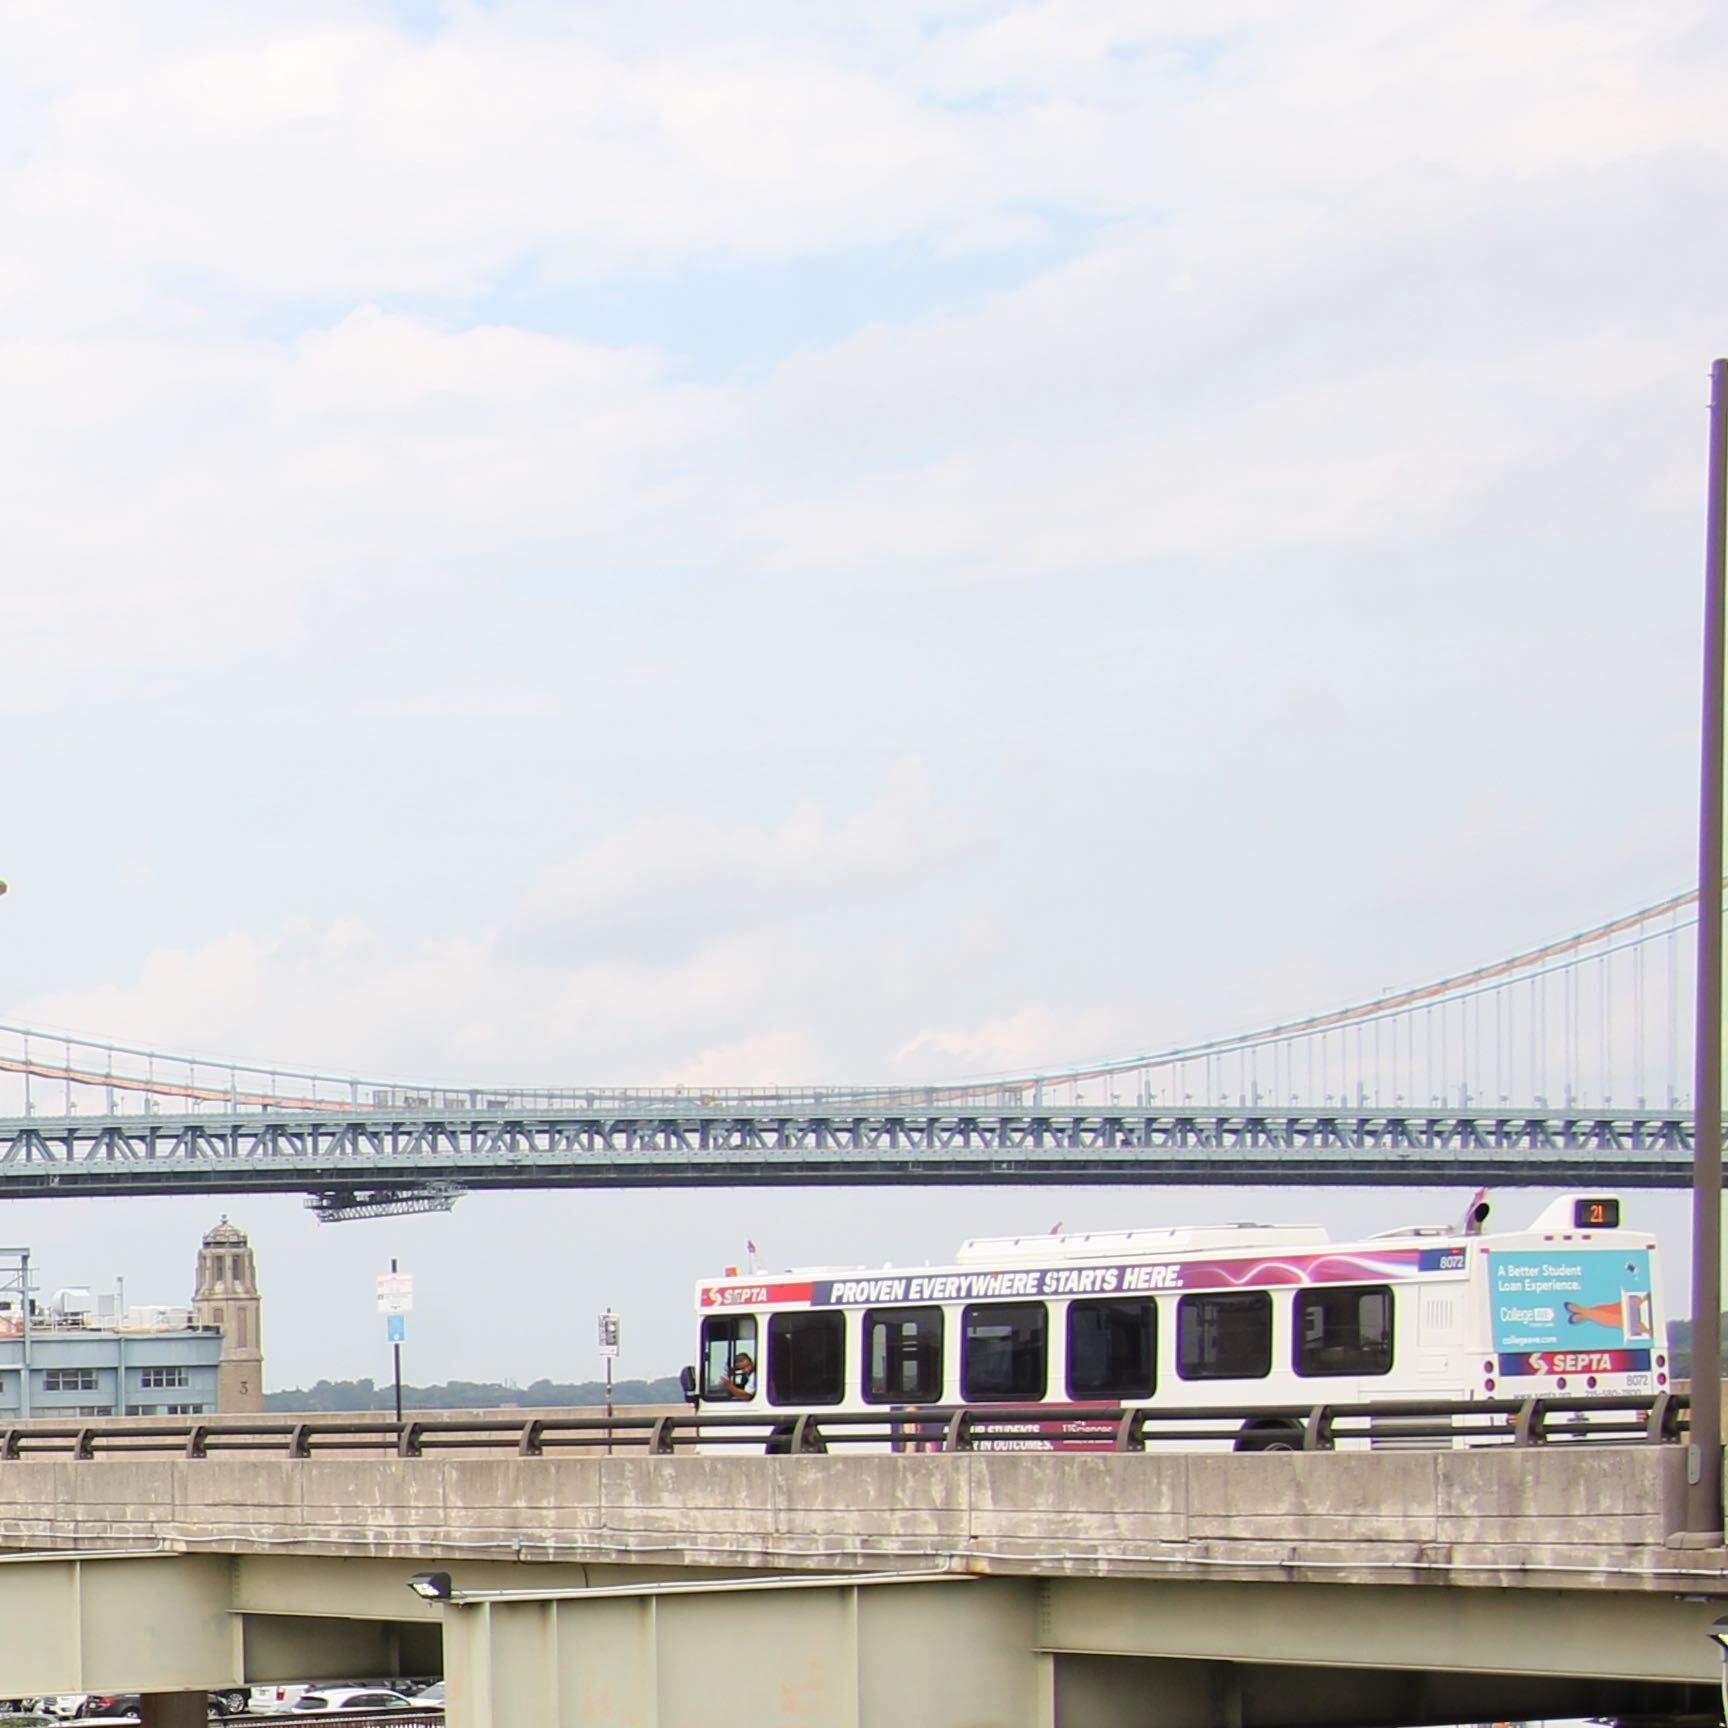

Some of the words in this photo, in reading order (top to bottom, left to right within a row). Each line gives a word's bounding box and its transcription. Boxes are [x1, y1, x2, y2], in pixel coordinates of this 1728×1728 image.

[1590, 1204, 1604, 1223] 21
[1440, 1256, 1465, 1269] 8072
[1497, 1265, 1506, 1276] A
[1507, 1265, 1540, 1277] Better
[1542, 1264, 1582, 1276] Student
[830, 1277, 905, 1303] PROVEN
[908, 1270, 1040, 1299] EVERYWHERE
[1042, 1267, 1120, 1294] STARTS
[1122, 1264, 1184, 1289] HERE.
[1498, 1280, 1522, 1292] Loan
[1524, 1279, 1582, 1294] Experience.
[722, 1287, 769, 1306] SEPTA
[1500, 1307, 1534, 1324] College
[1552, 1353, 1613, 1373] SEPTA
[1626, 1375, 1649, 1386] 8072
